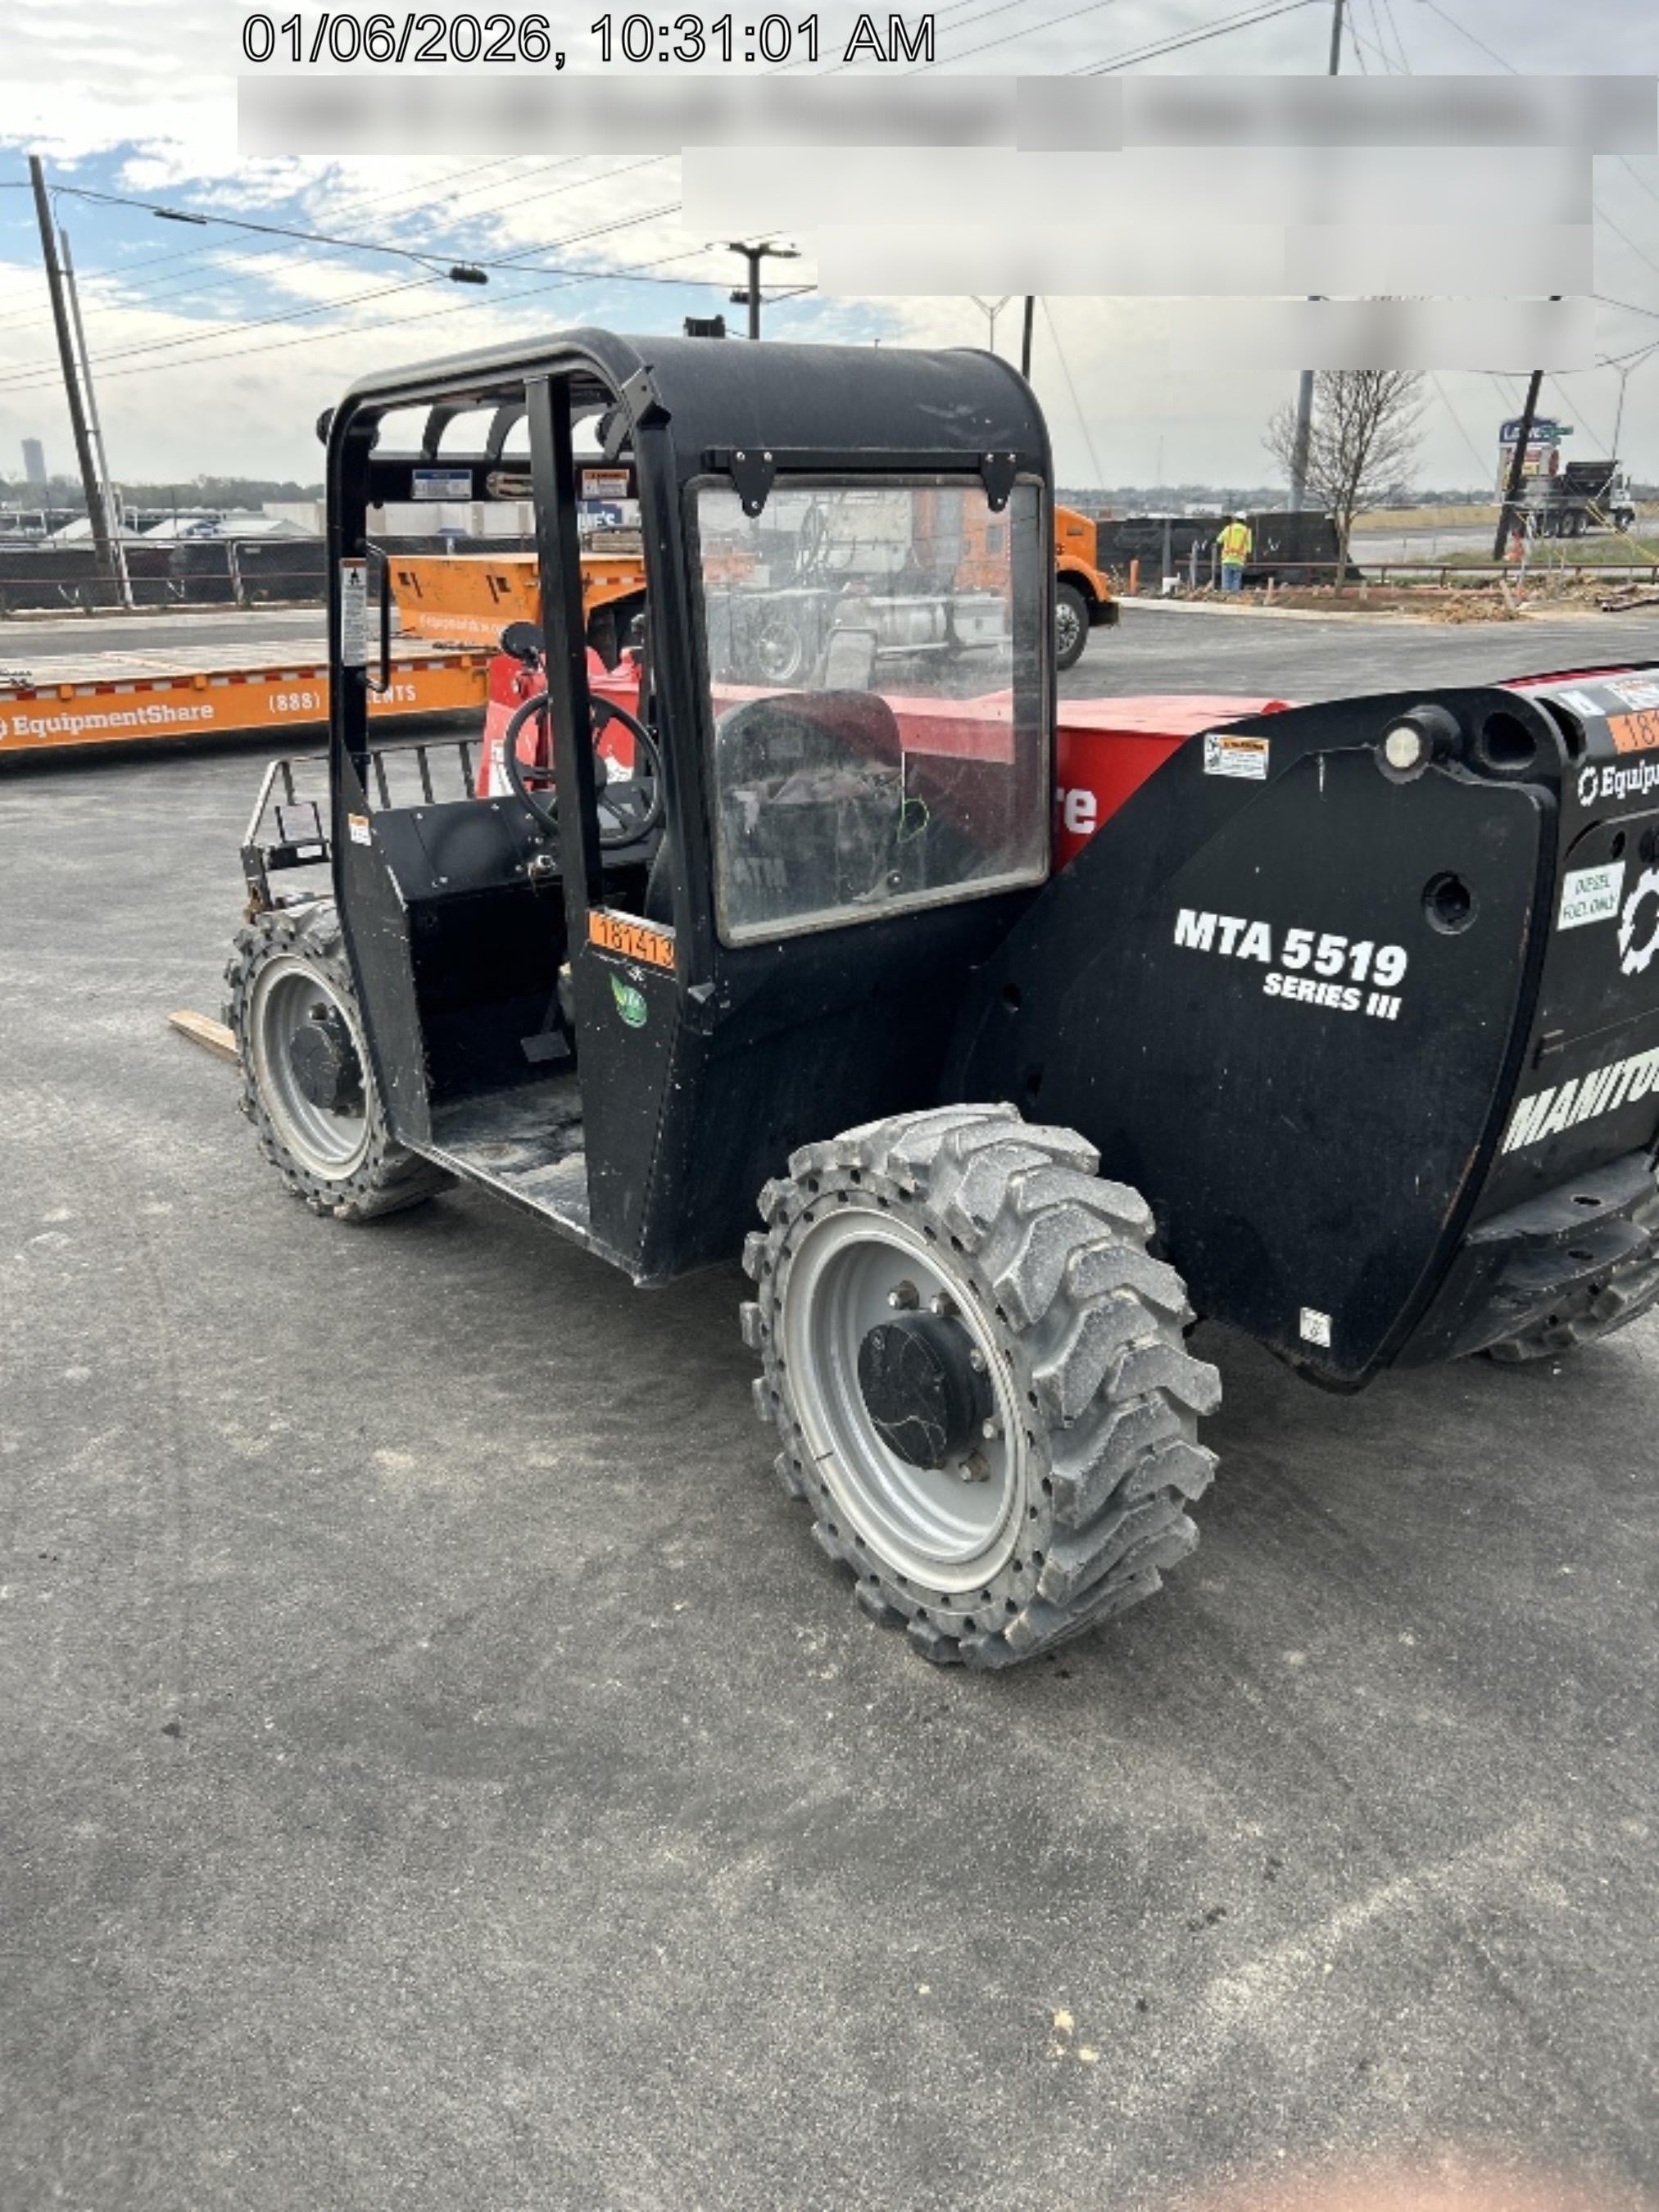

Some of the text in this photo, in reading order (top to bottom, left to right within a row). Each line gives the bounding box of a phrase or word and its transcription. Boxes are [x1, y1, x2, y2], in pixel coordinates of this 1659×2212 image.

[11, 685, 415, 737] EquipmentShare (888) ENTS
[1173, 909, 1407, 986] MTA 5519
[1262, 972, 1402, 1021] SERIES III
